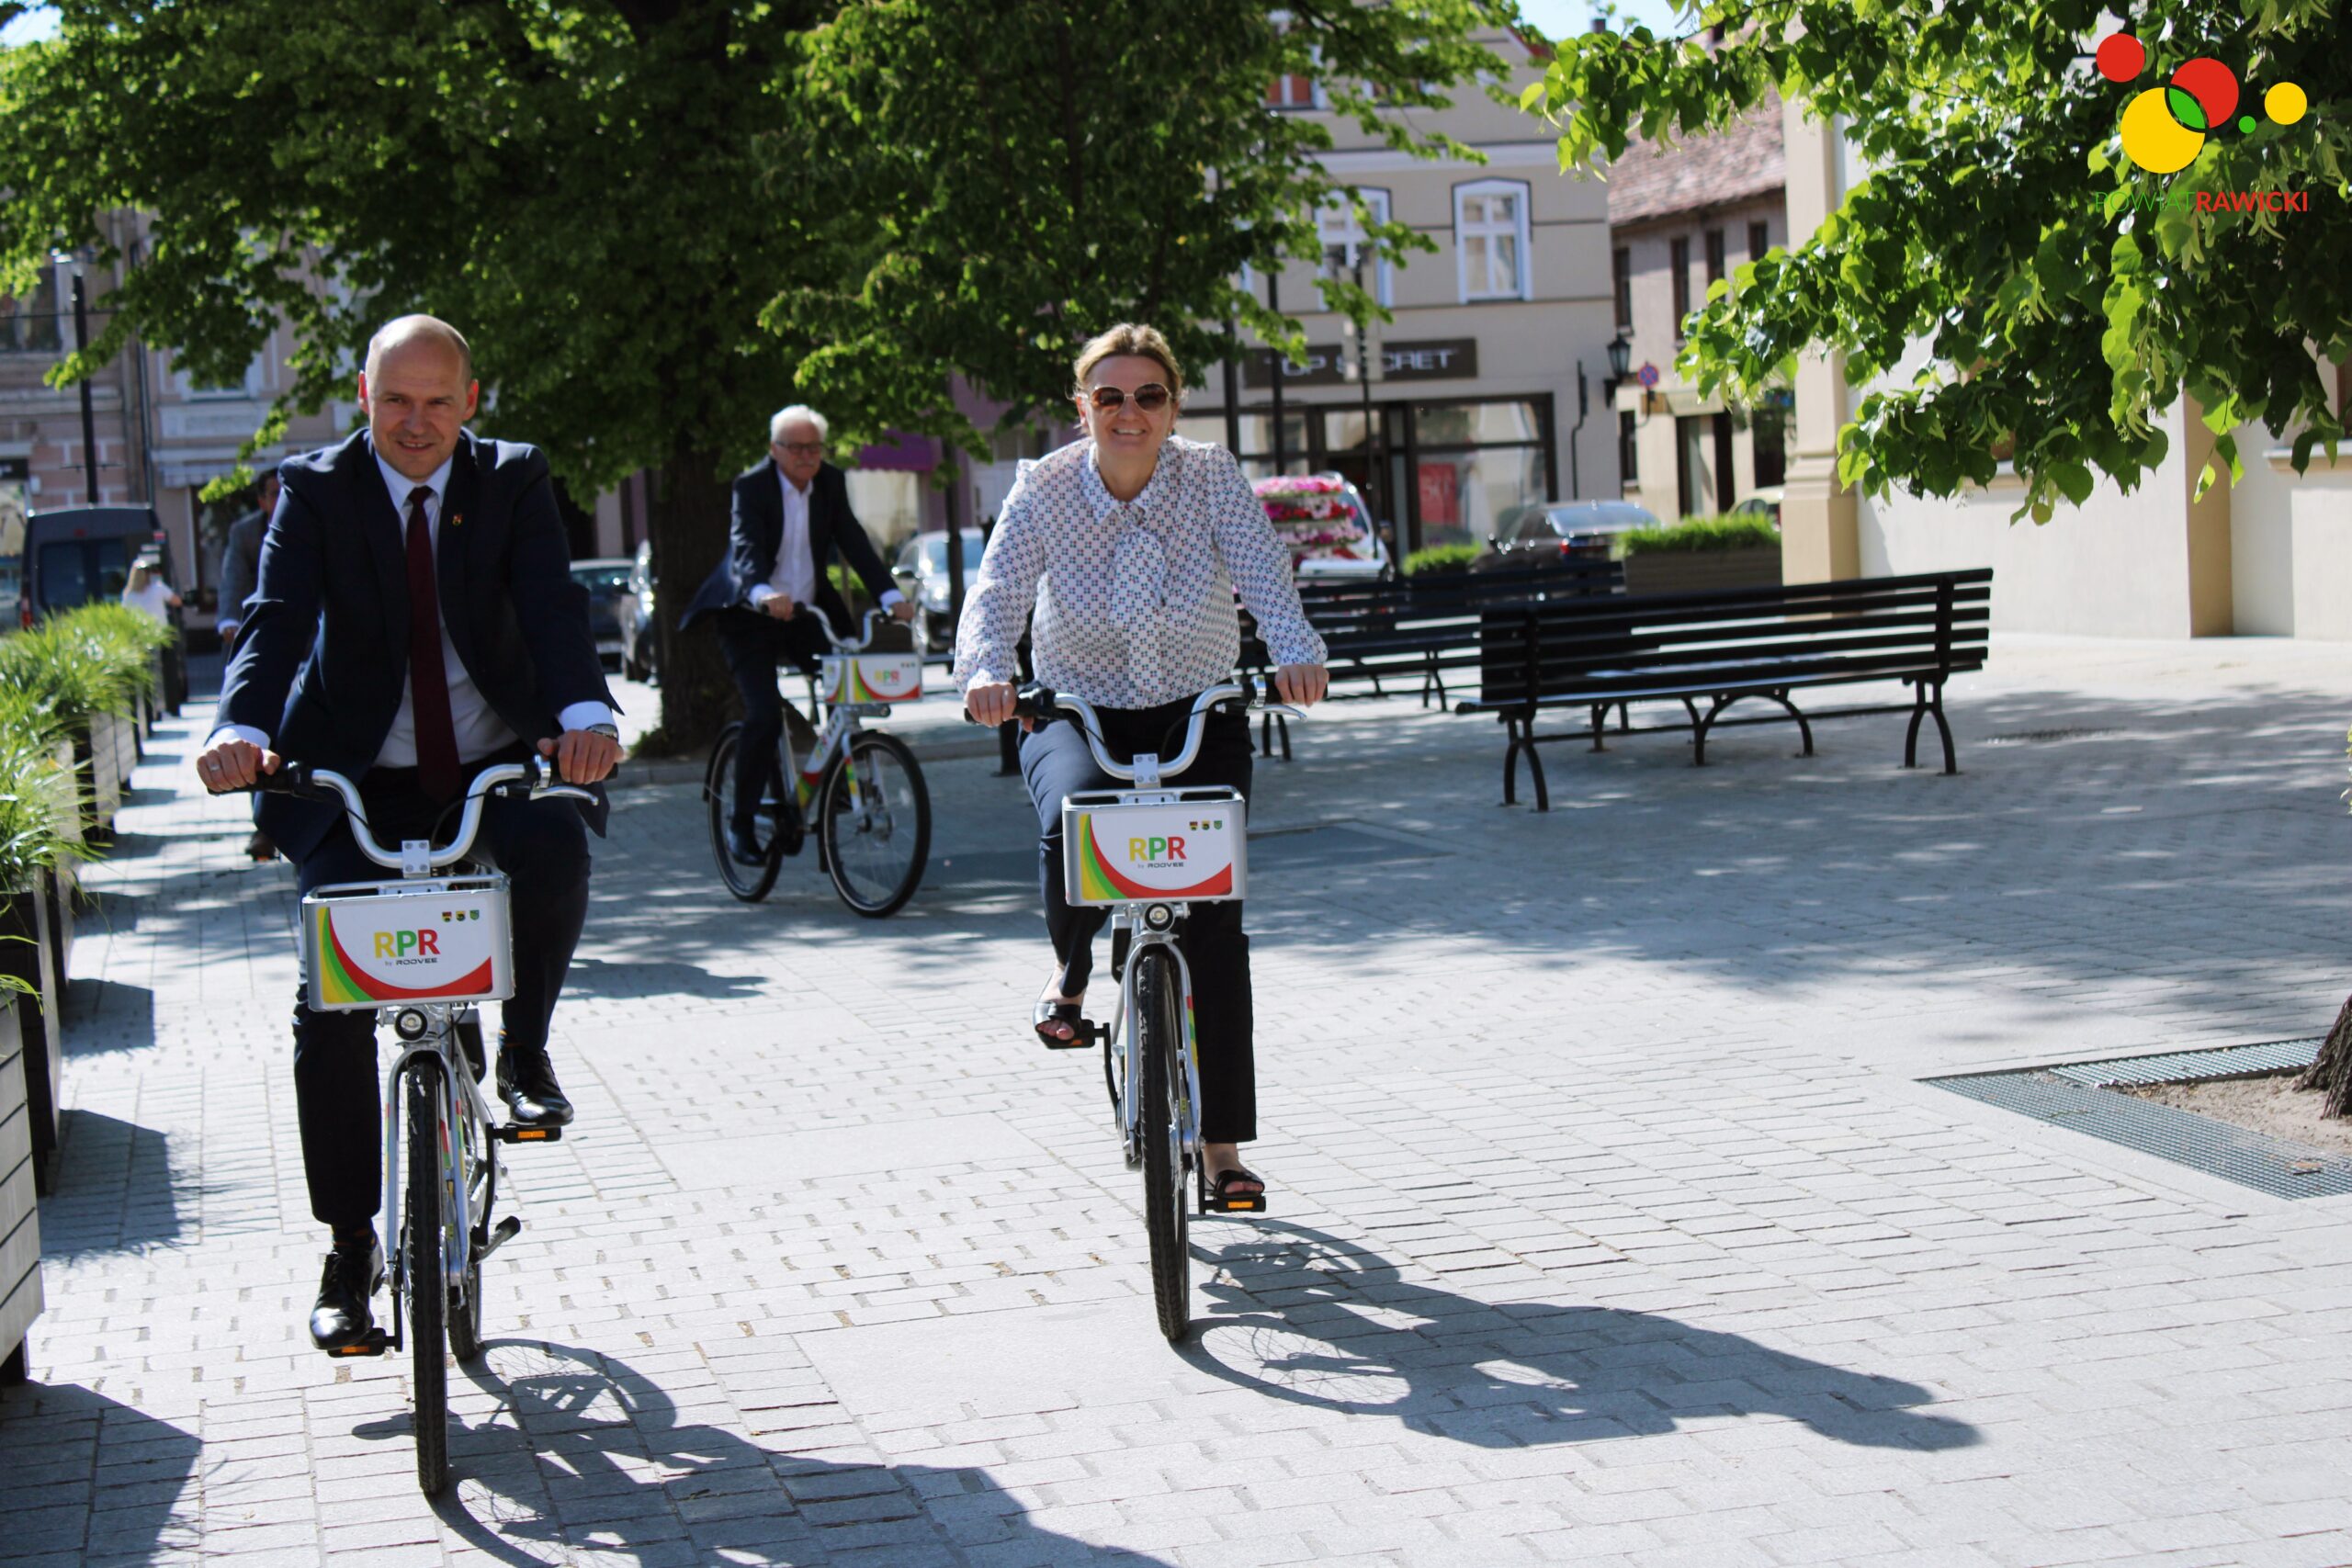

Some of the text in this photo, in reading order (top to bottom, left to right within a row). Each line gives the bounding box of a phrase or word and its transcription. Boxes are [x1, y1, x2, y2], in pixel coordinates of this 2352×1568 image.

[1128, 837, 1187, 862] RPR
[373, 929, 441, 959] RPR
[396, 957, 438, 966] ROOVEE
